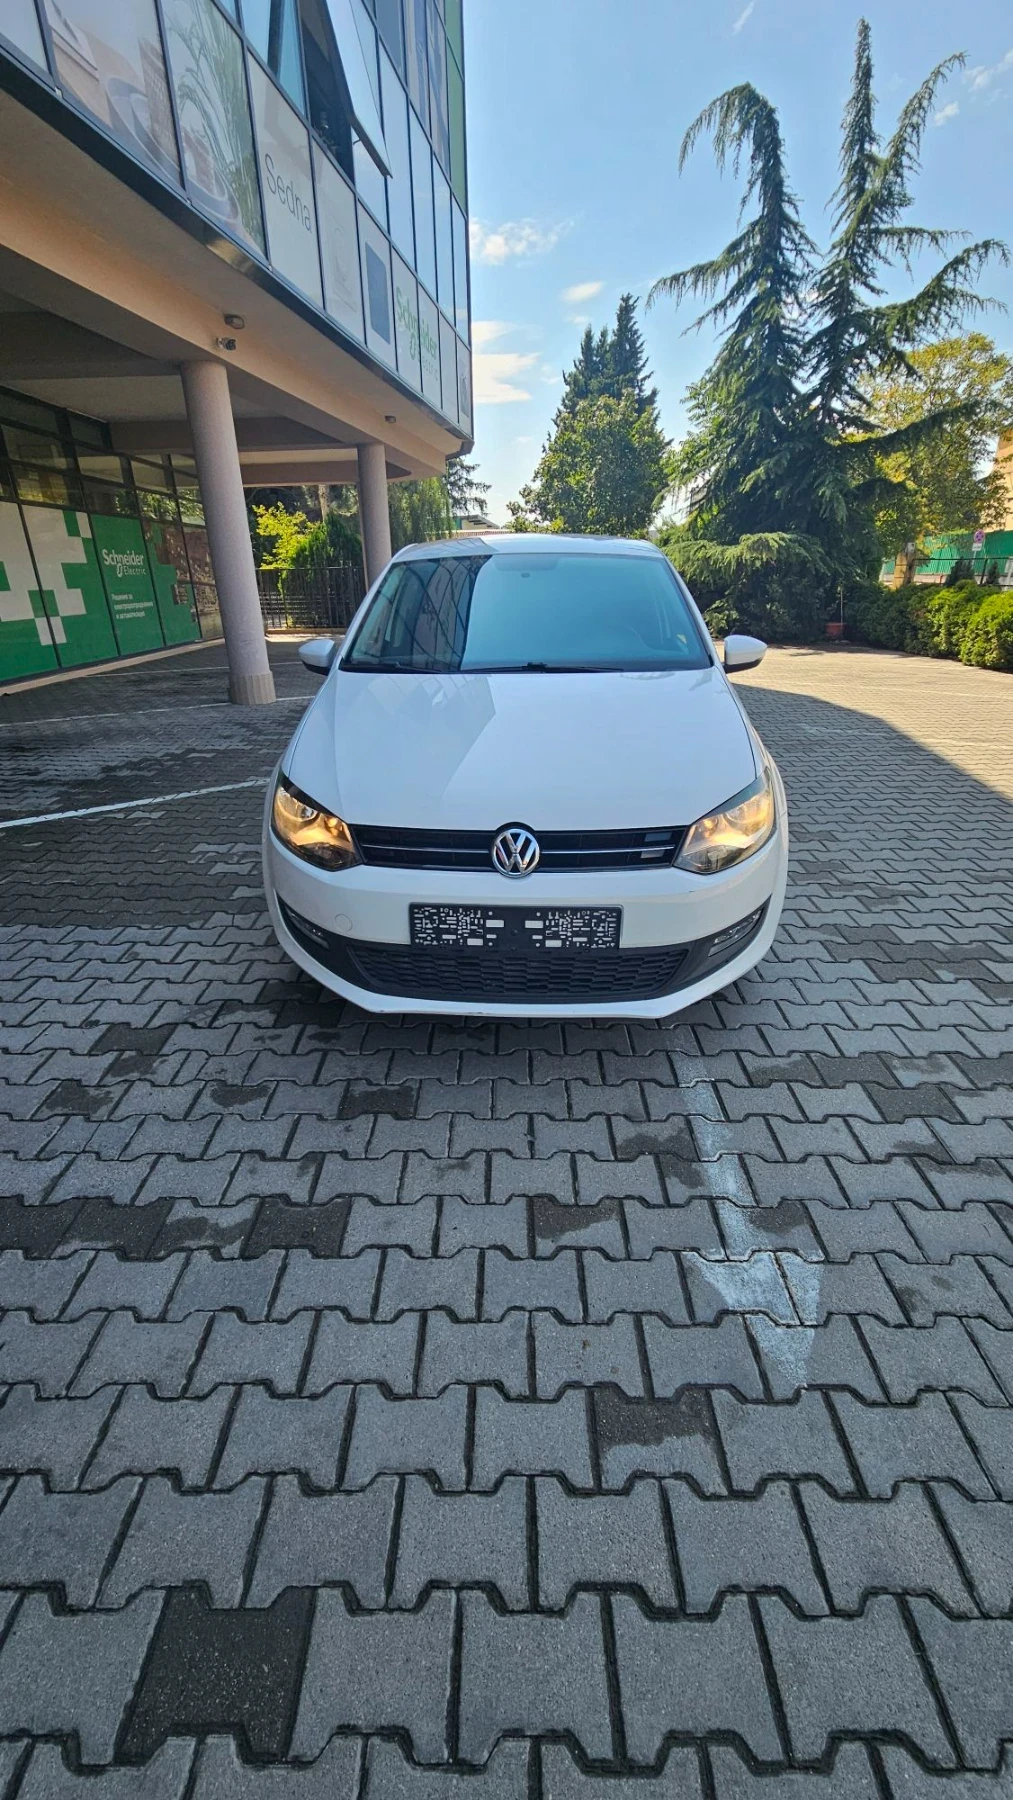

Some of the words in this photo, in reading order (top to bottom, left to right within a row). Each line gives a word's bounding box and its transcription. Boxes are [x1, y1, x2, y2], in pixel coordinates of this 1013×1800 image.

[265, 153, 312, 233] Sedna
[396, 286, 437, 360] Schnider
[102, 549, 144, 565] Schneider
[124, 565, 147, 575] Electric
[493, 829, 540, 878] VW
